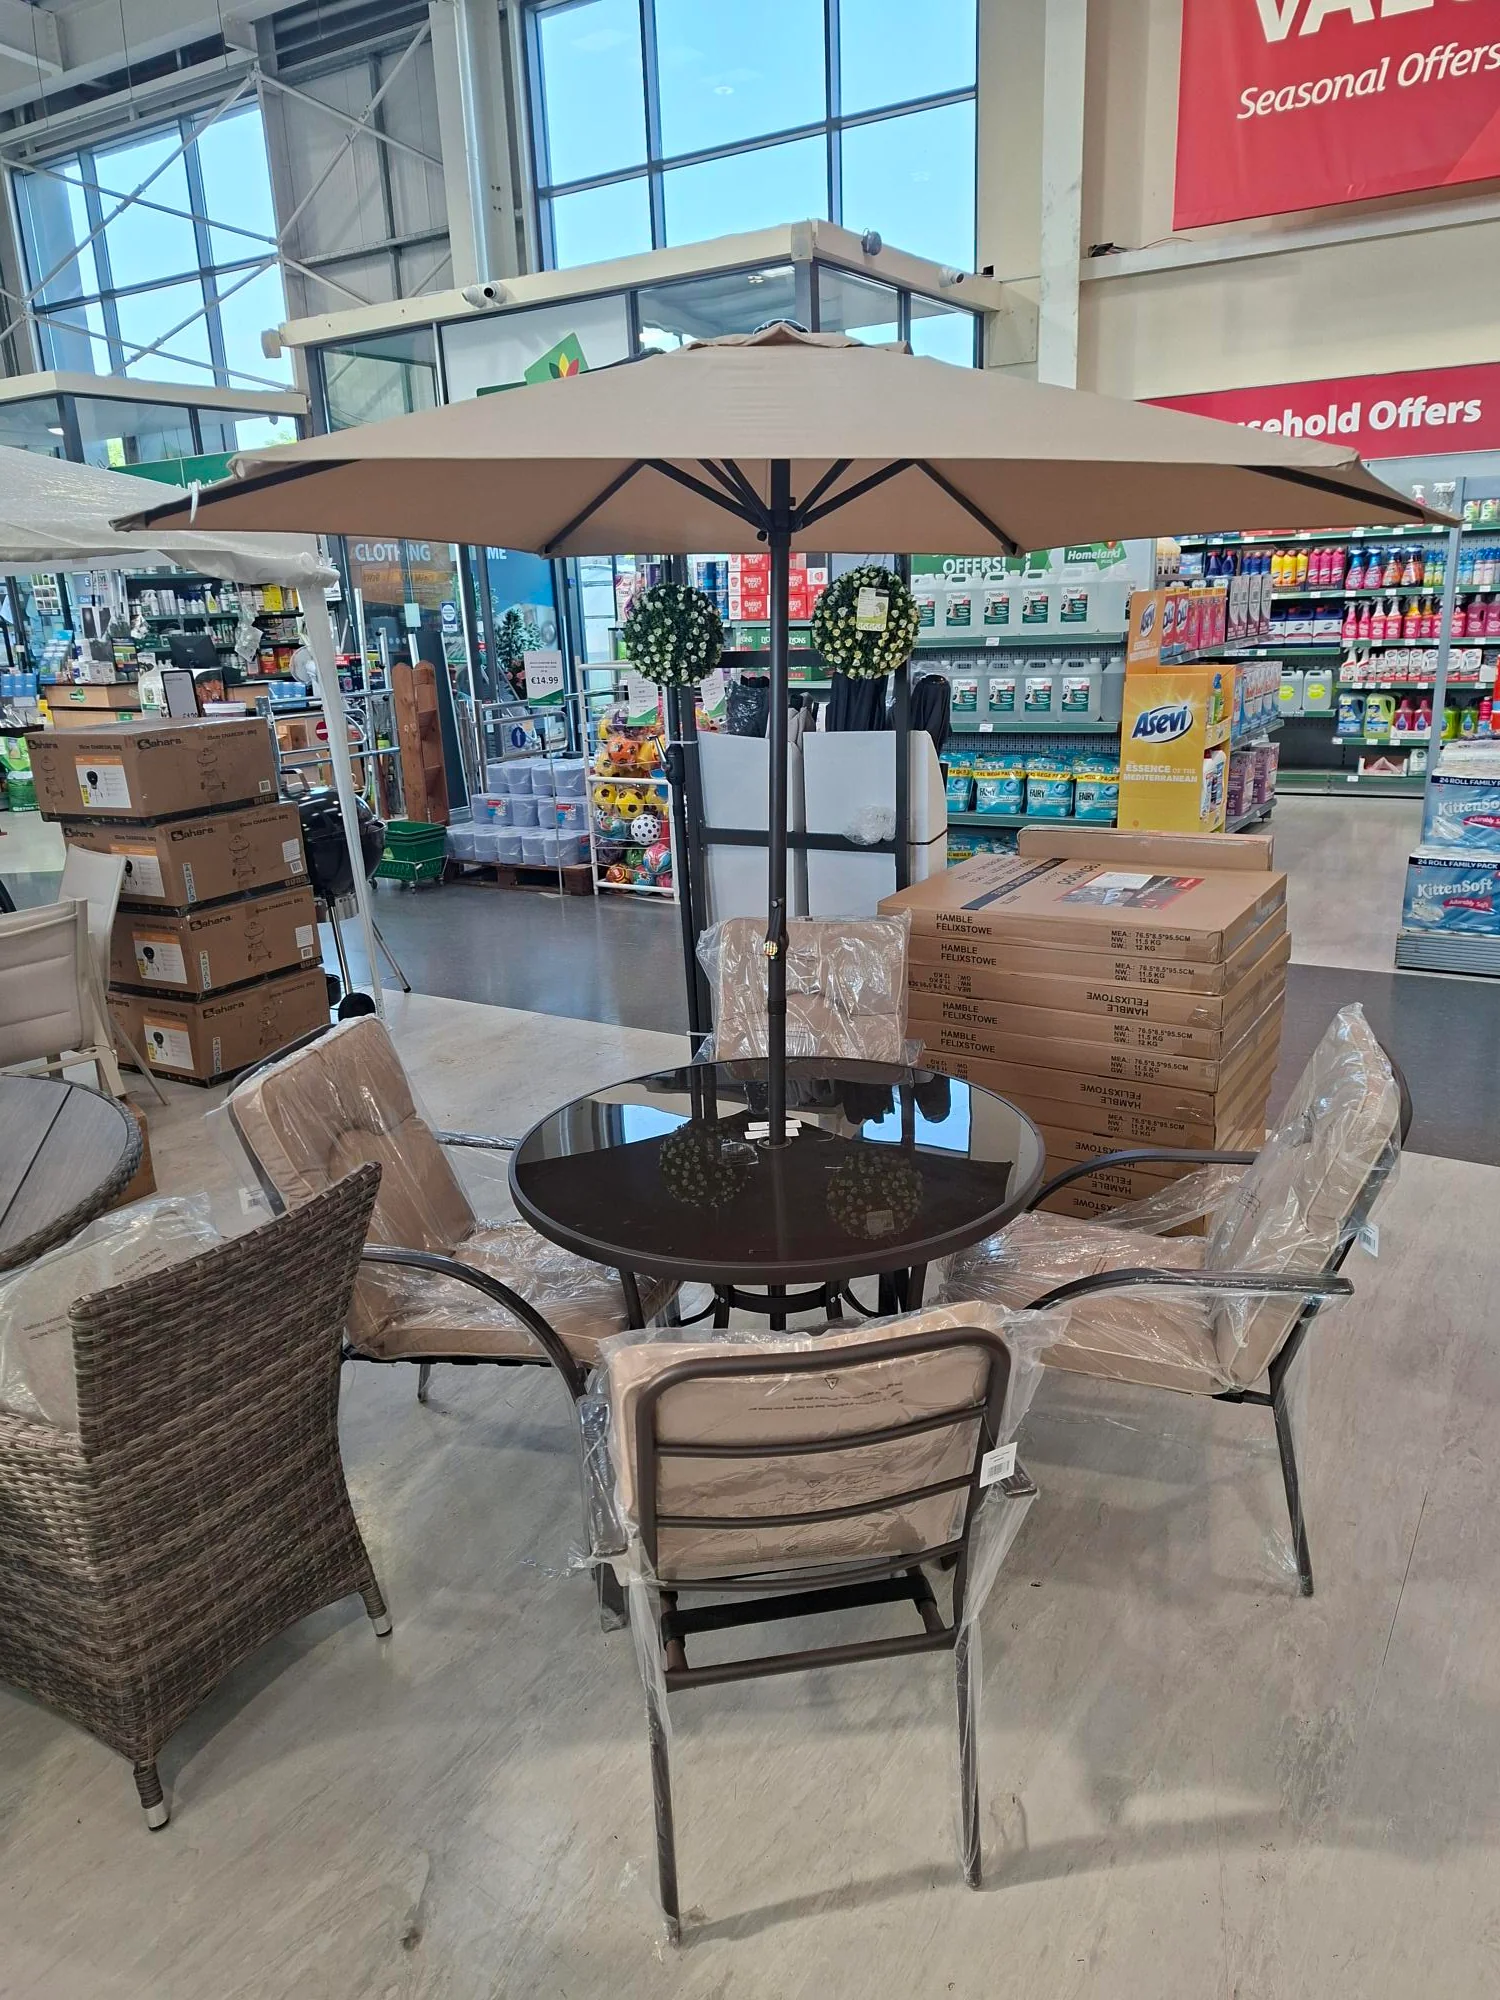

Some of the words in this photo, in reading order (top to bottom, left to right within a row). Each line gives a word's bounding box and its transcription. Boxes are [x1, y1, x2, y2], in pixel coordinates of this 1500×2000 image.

[1237, 57, 1390, 119] Seasonal
[1397, 42, 1500, 87] Offers
[1237, 402, 1361, 437] ehold
[1369, 395, 1482, 430] Offers
[355, 543, 431, 562] CLOTHNG
[1067, 548, 1121, 562] Homeland
[943, 556, 1006, 575] OFFERS!
[531, 676, 559, 685] €14.99
[1132, 705, 1188, 738] Asevi
[27, 739, 58, 750] Sahara
[138, 738, 182, 750] Sahara
[1126, 764, 1171, 773] ESSENCE
[1123, 773, 1198, 783] MEDITERRANEAN
[1029, 788, 1046, 799] FAIRY
[1079, 792, 1095, 801] FAIRY
[64, 827, 94, 839] Sahara
[170, 827, 215, 842] Sahara
[1417, 878, 1493, 899] KittenSoft
[190, 915, 231, 931] Sahara
[936, 913, 973, 924] HAMBLE
[936, 923, 992, 936] FELIXSTOWE
[941, 944, 978, 954] HAMBLE
[941, 953, 997, 966] FELIXSTOWE
[1086, 991, 1149, 1007] FELIXSTOWE
[203, 1001, 244, 1019] Sahara
[942, 1001, 979, 1013] HAMBLE
[1107, 1003, 1149, 1016] HAMBLE
[942, 1011, 998, 1025] FELIXSTOWE
[941, 1029, 977, 1041] HAMBLE
[940, 1039, 996, 1053] FELIXSTOWE
[1080, 1083, 1141, 1100] FELIXSTOWE
[1100, 1096, 1141, 1109] HAMBLE
[1092, 1181, 1132, 1195] HAMBLE
